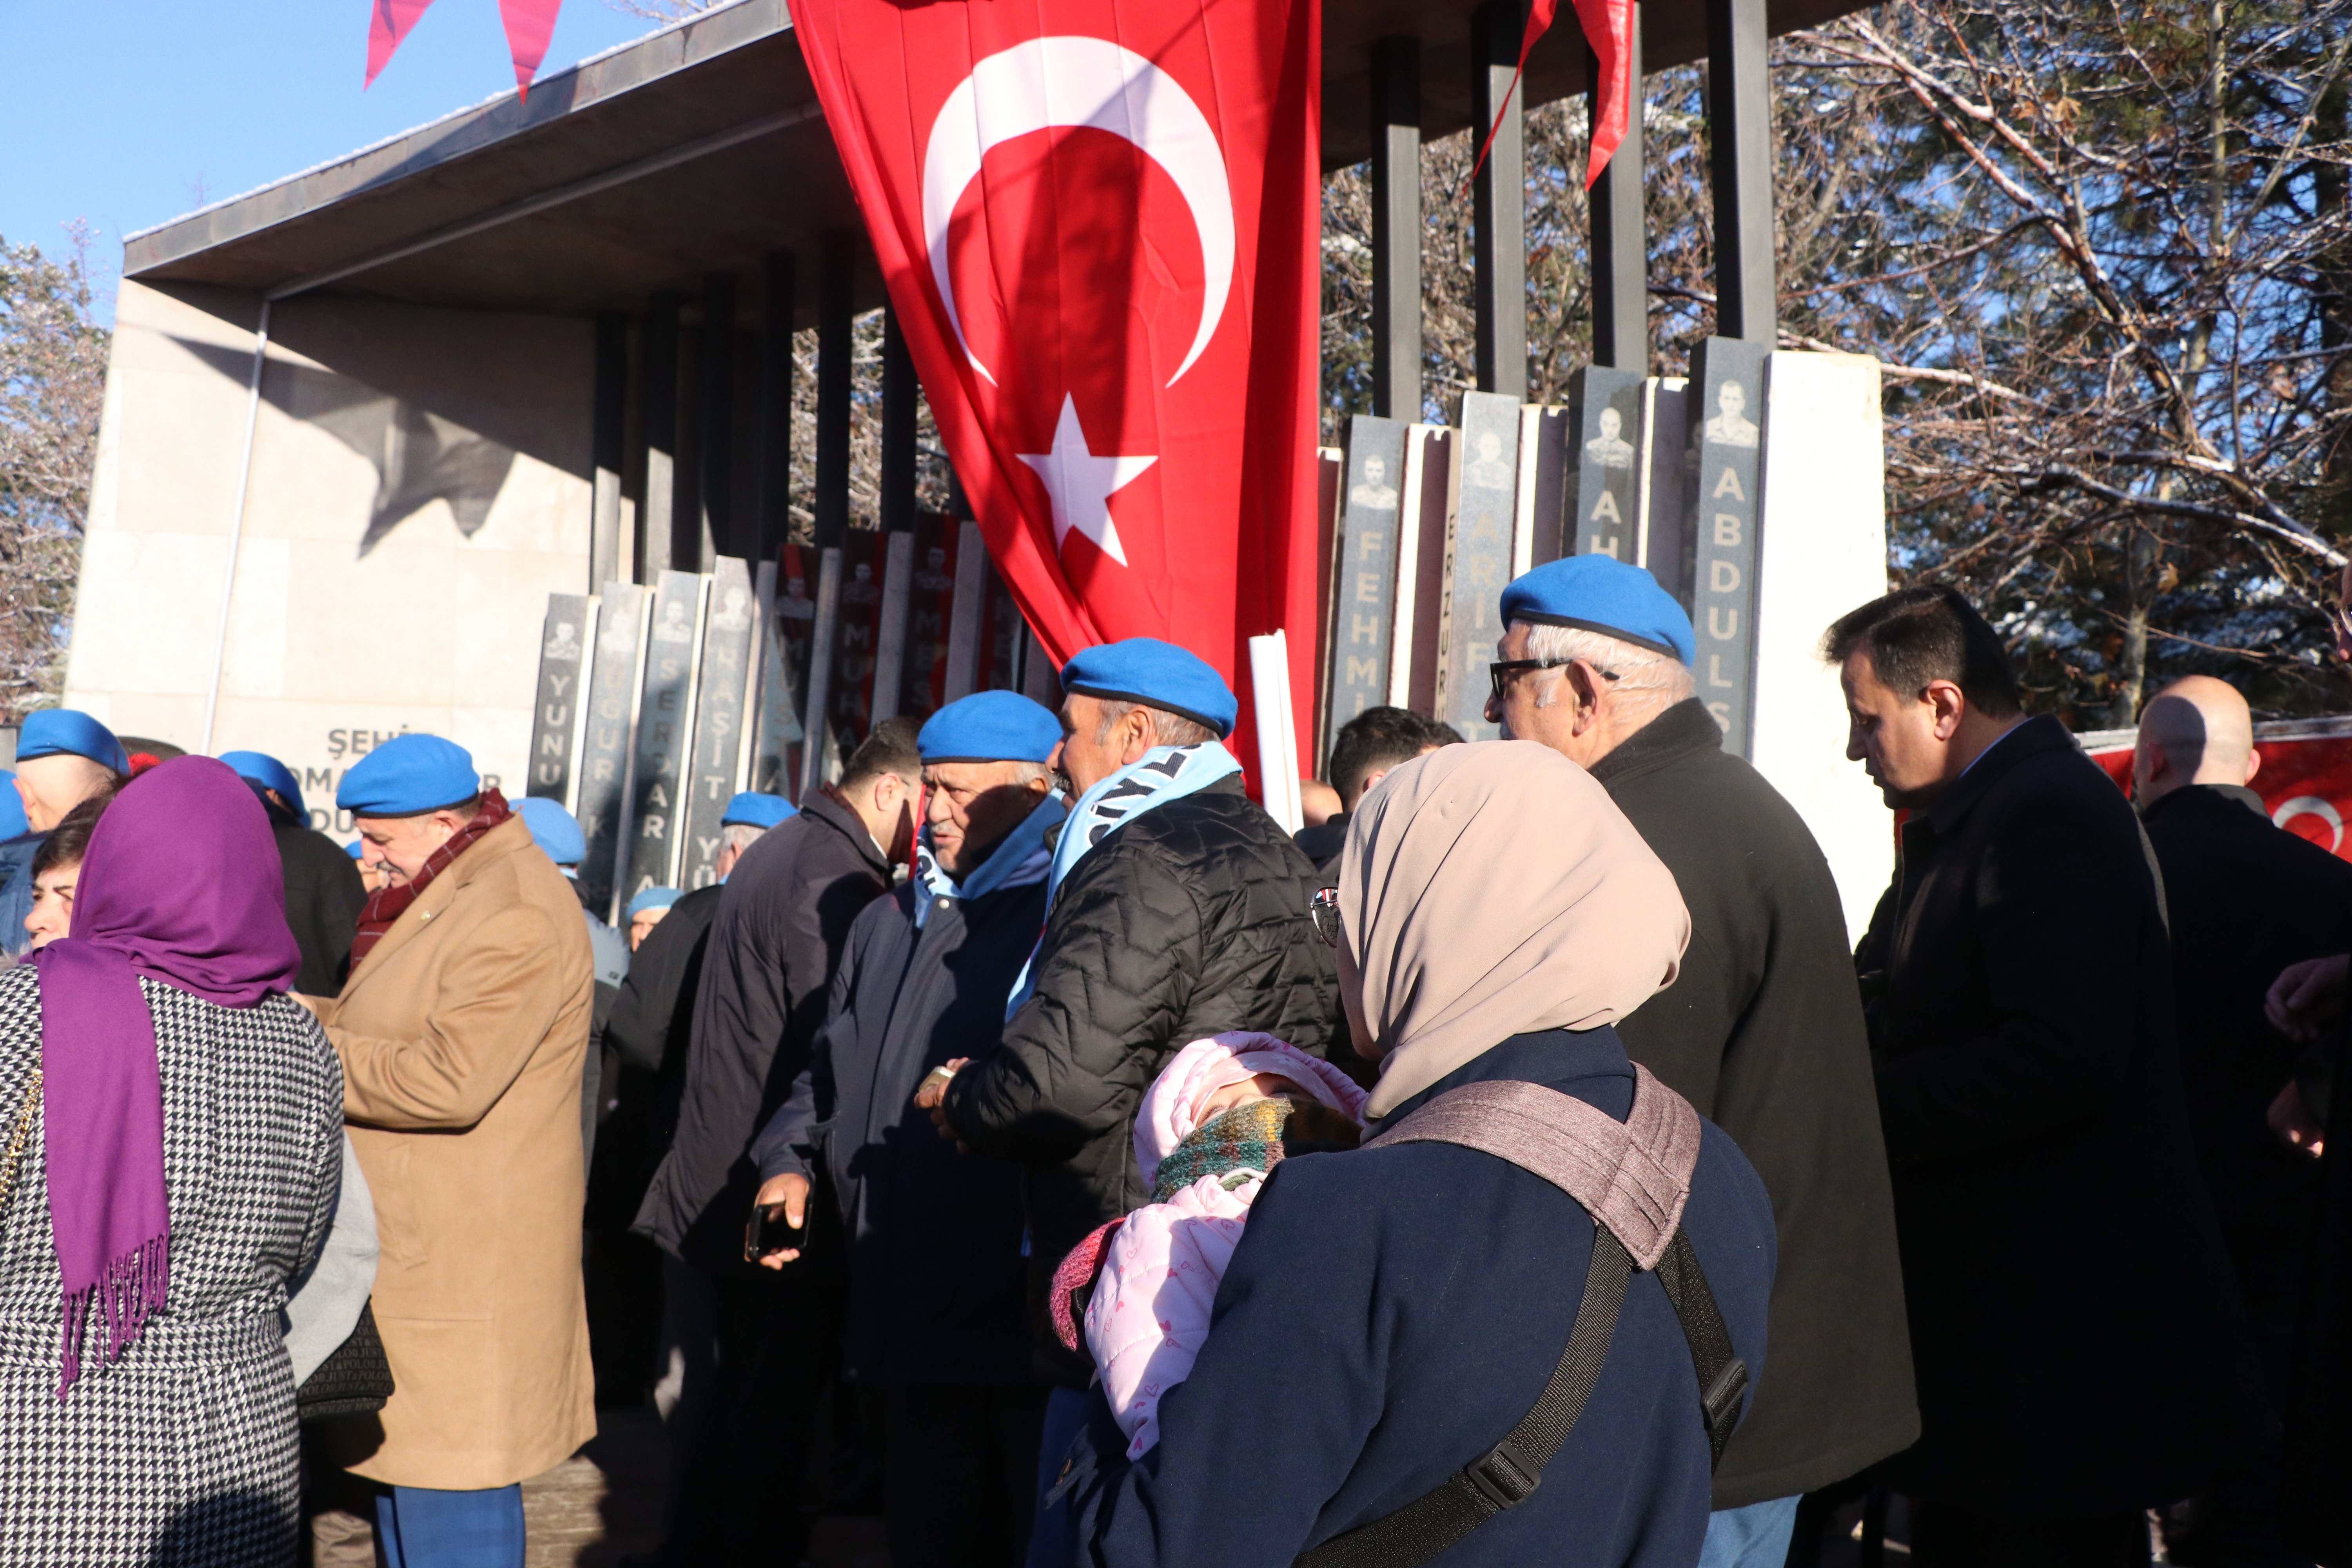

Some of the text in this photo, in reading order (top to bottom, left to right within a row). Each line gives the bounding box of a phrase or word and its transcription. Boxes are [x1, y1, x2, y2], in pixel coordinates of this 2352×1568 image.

[1590, 491, 1621, 559] AH
[1707, 467, 1744, 734] ABDULS
[838, 623, 870, 746] MUHA
[911, 610, 942, 706] MES
[539, 674, 572, 785] YUNU
[642, 658, 678, 839] SERDAR
[1462, 721, 1486, 742] T
[310, 808, 355, 834] DU
[693, 836, 720, 890] YÜ
